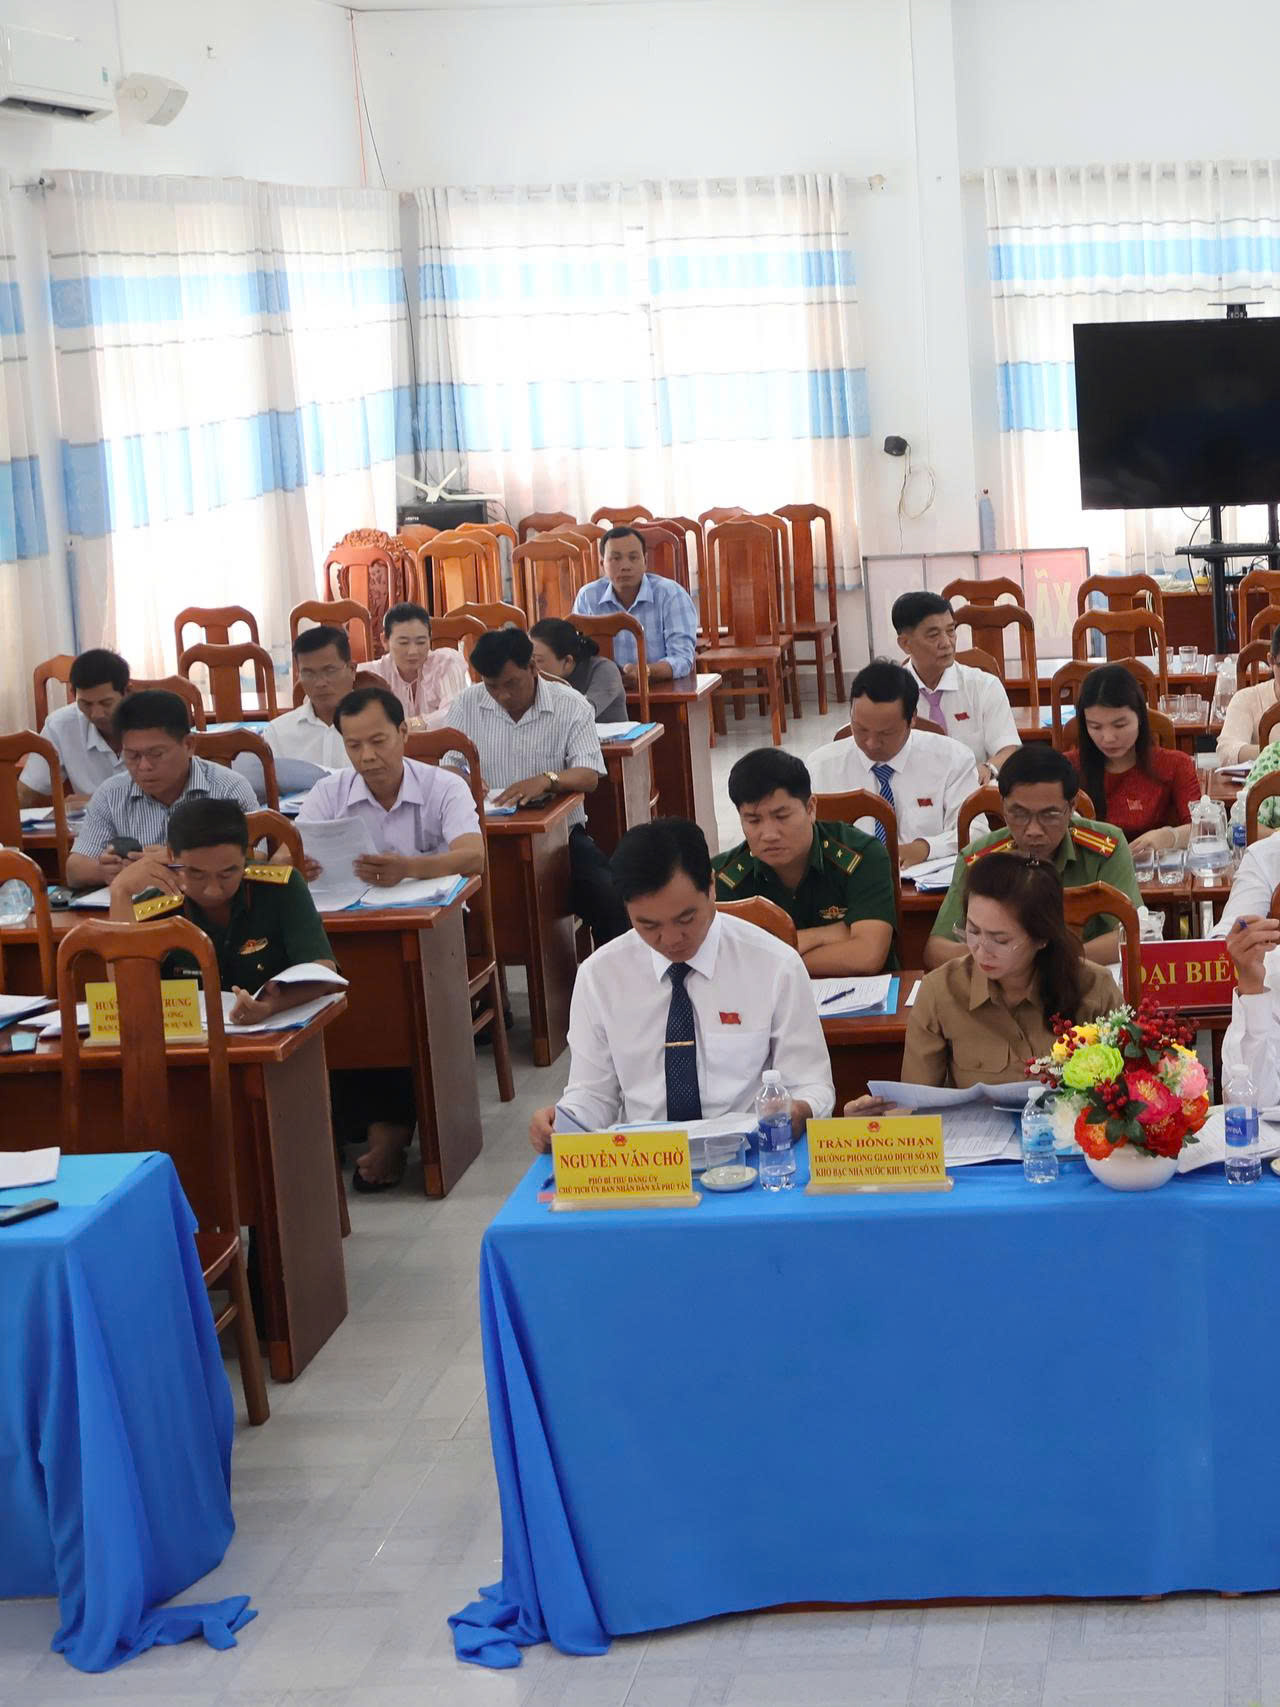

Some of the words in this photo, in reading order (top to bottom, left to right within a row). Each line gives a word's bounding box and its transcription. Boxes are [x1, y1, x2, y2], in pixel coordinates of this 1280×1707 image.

[1184, 953, 1239, 983] BIỂ
[163, 998, 192, 1008] RUNG
[897, 1136, 934, 1149] NHẠN
[560, 1149, 617, 1168] NGUYỄN
[621, 1149, 649, 1167] VĂN
[653, 1147, 684, 1166] CHỜ
